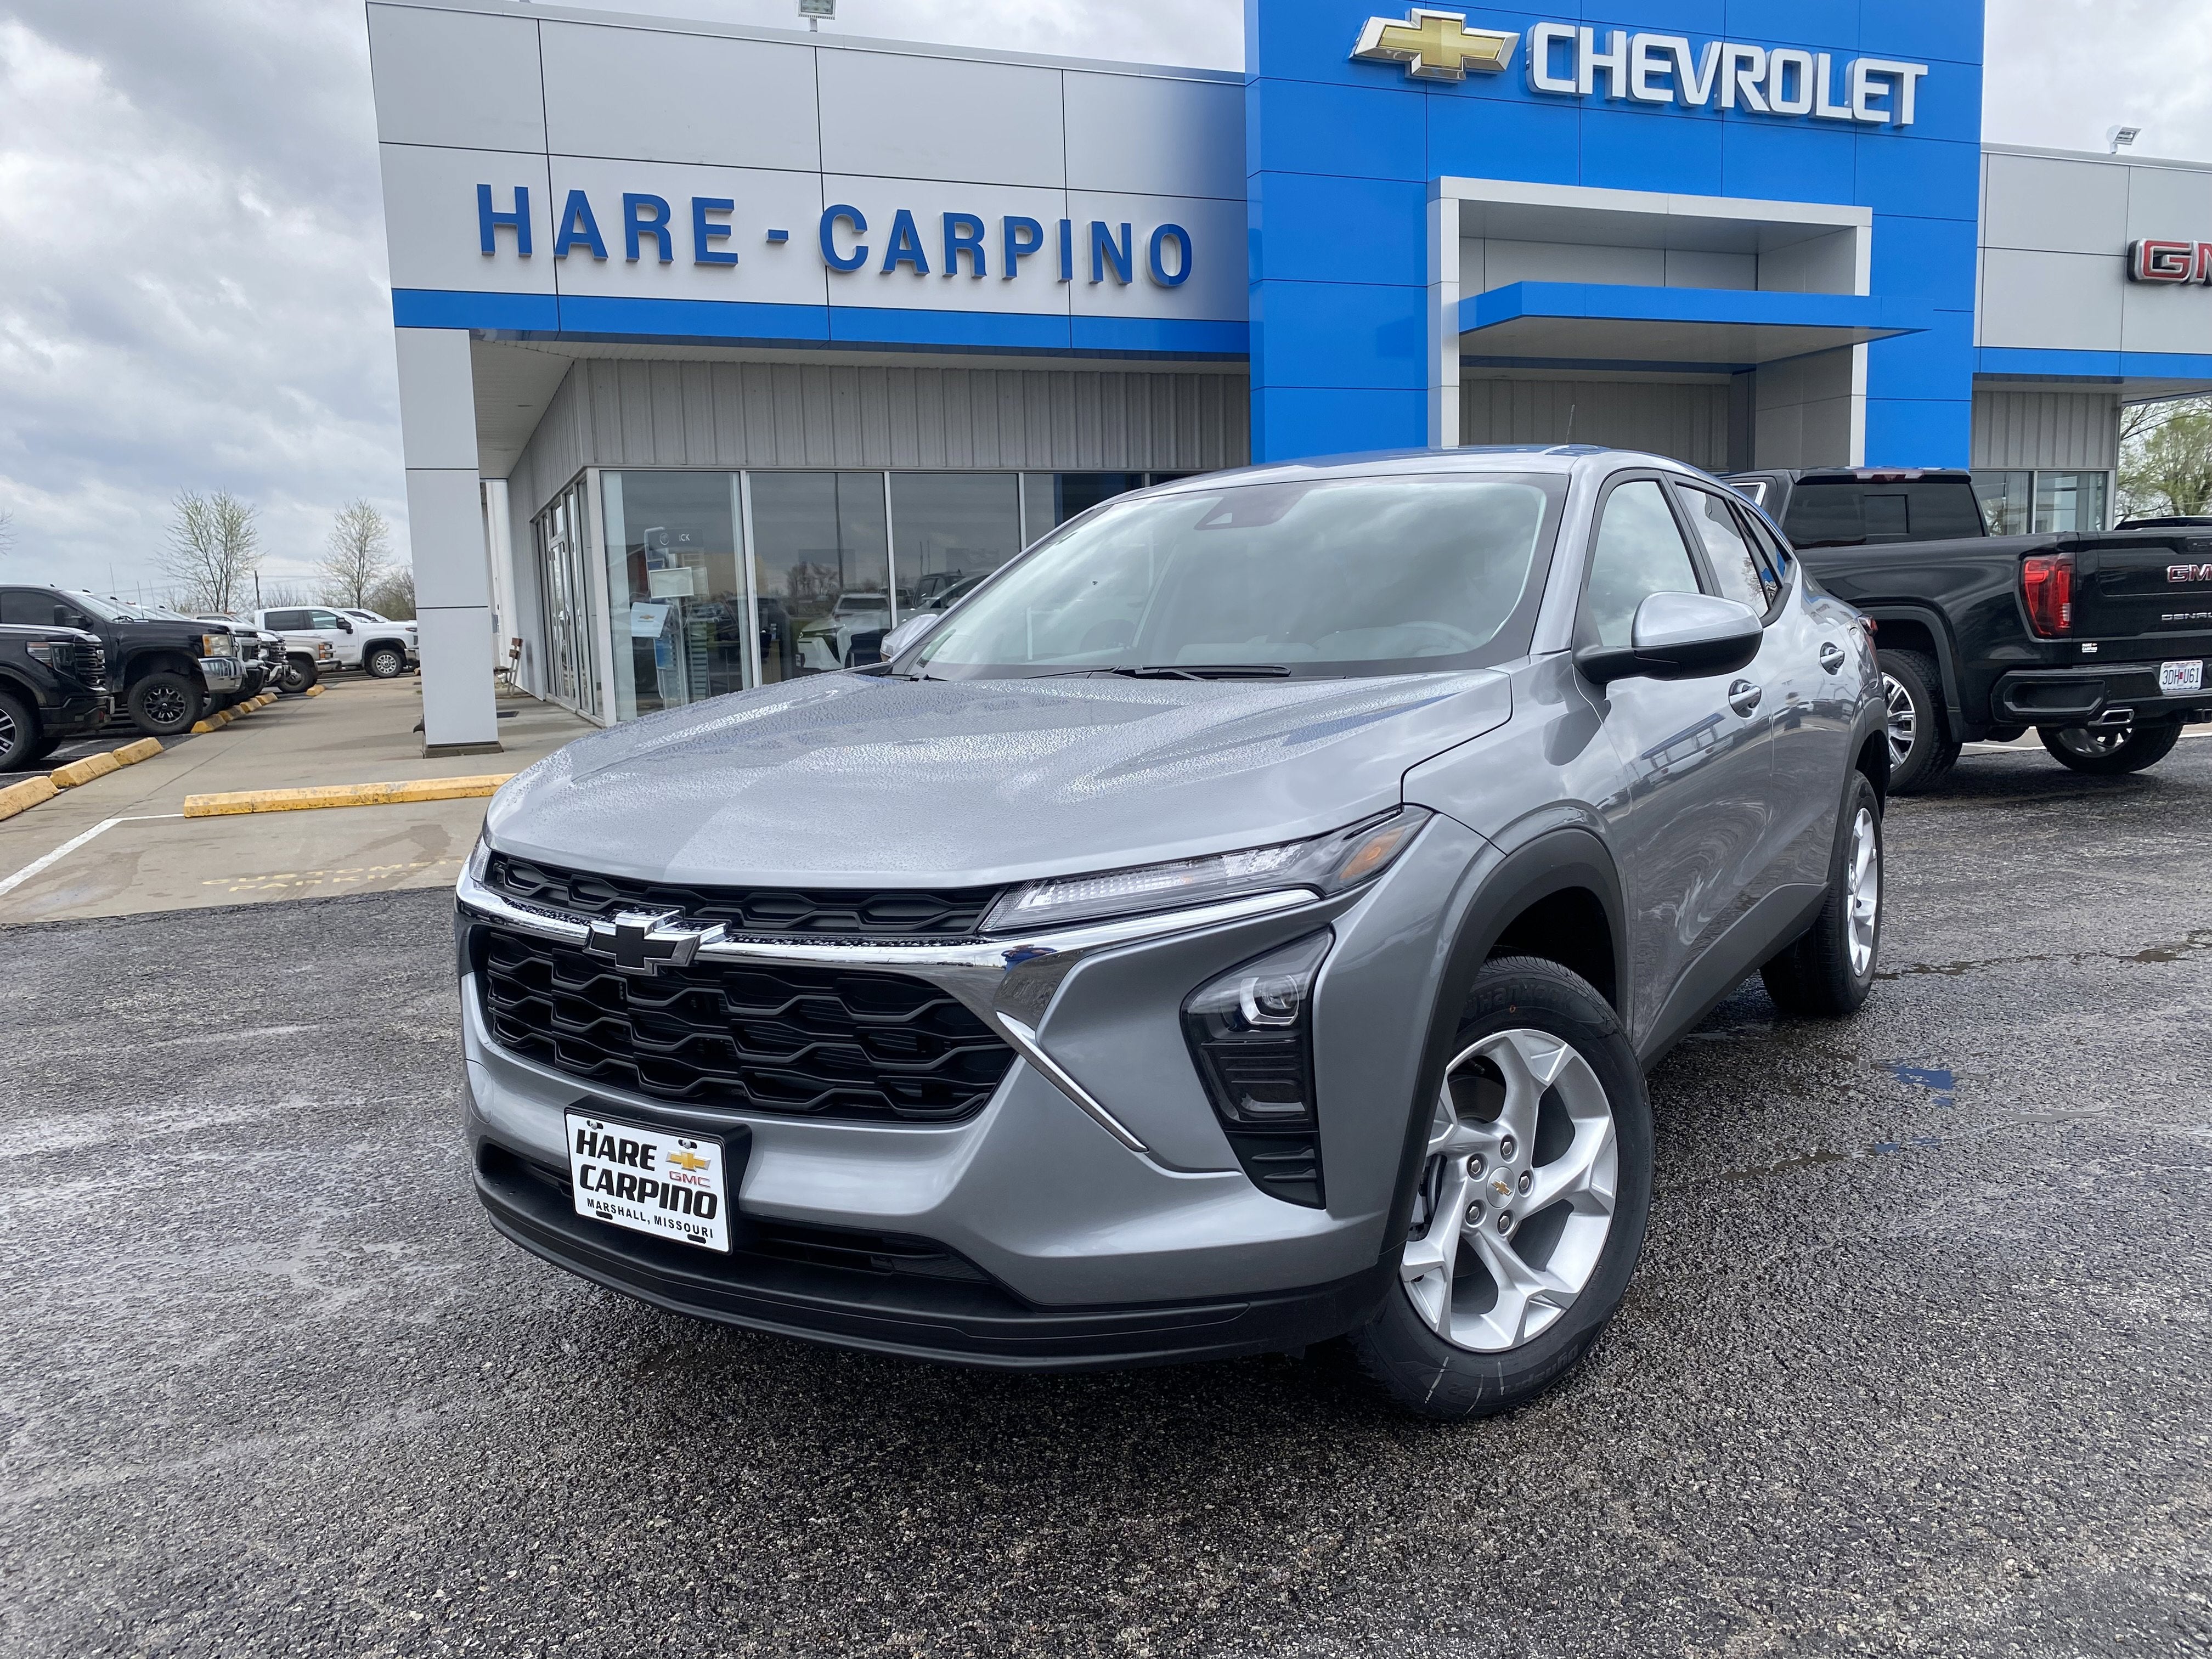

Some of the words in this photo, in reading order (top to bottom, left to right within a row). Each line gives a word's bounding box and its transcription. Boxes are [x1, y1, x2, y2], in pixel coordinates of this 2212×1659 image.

[1526, 21, 1928, 127] CHEVROLET
[476, 184, 738, 267] HARE
[819, 204, 1193, 289] CARPINO
[2163, 669, 2180, 685] 3DH
[576, 1128, 657, 1172] HARE
[579, 1164, 718, 1220] CARPINO
[668, 1170, 712, 1189] GMC
[586, 1198, 651, 1225] MARSHALL,
[654, 1215, 713, 1239] MISSOURI
